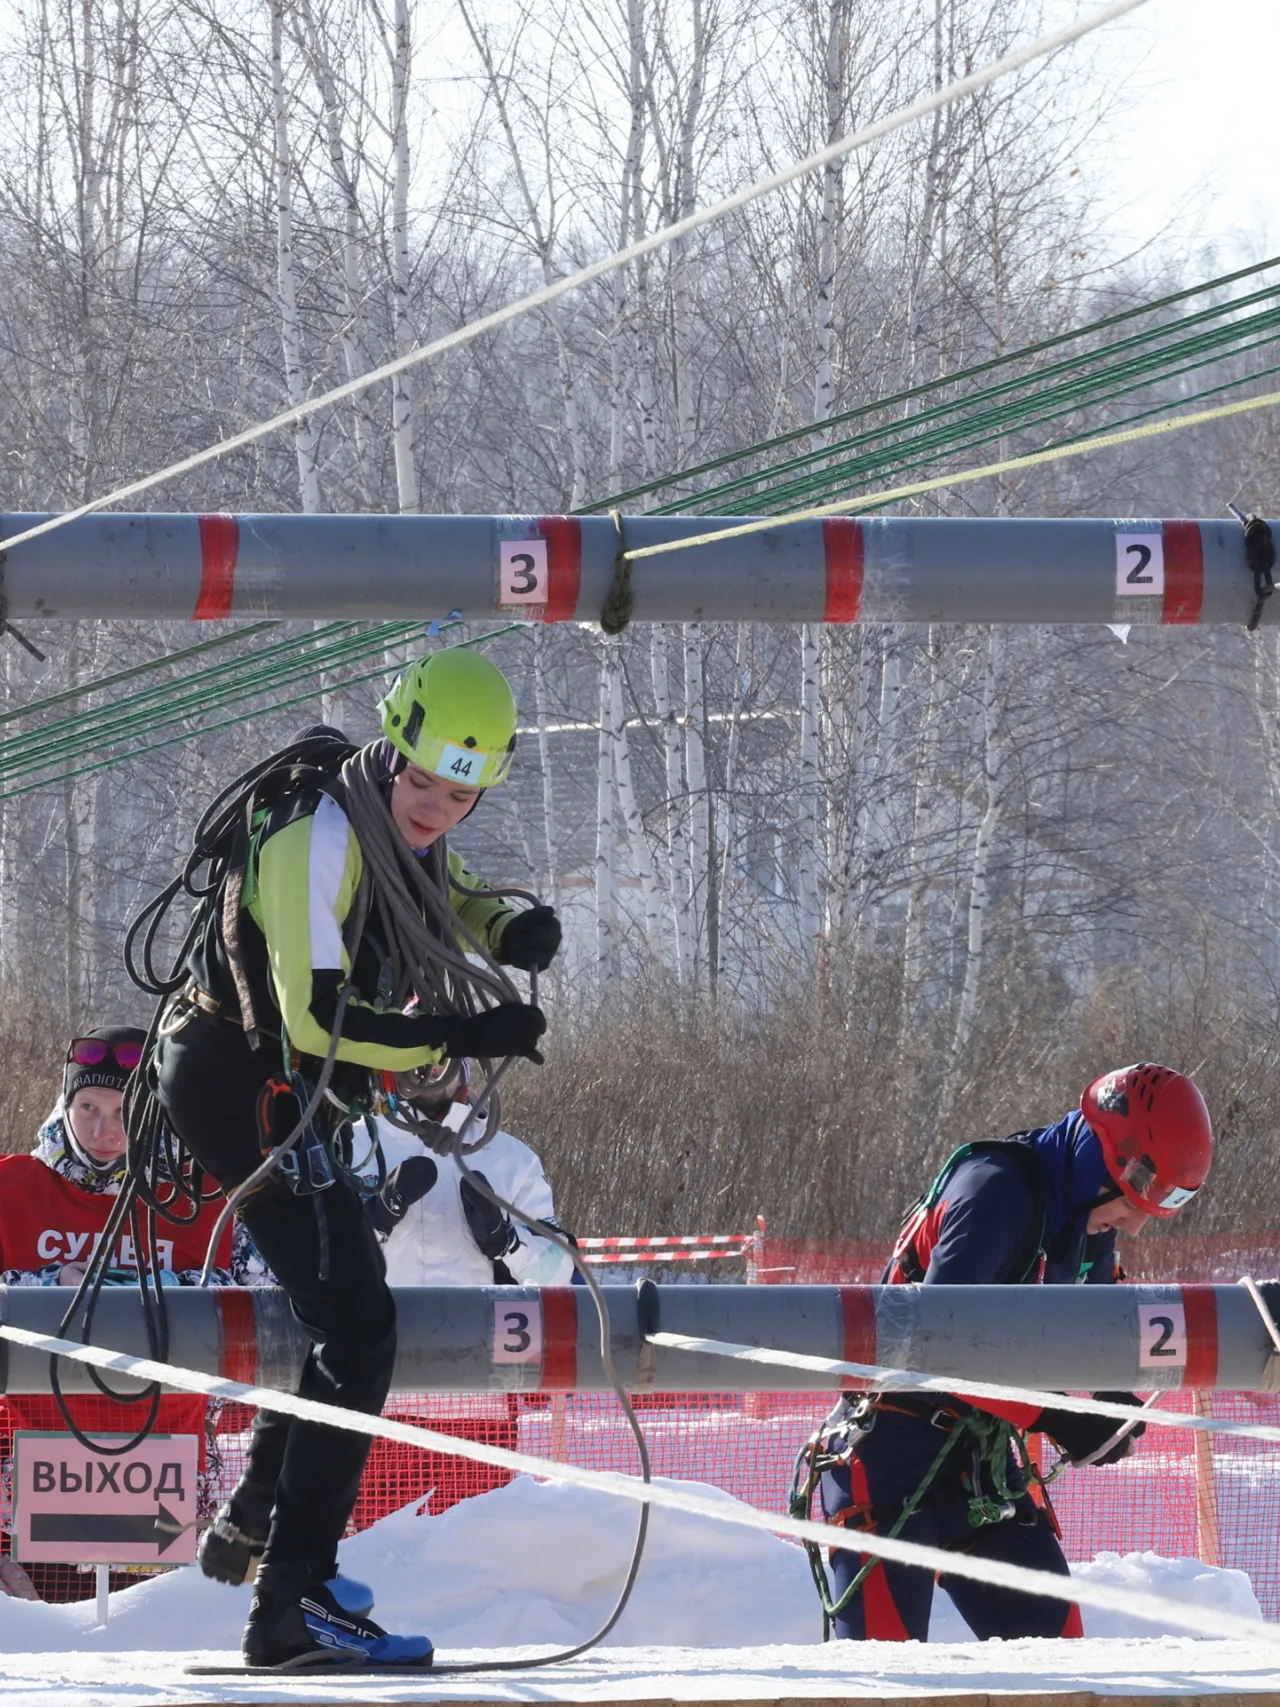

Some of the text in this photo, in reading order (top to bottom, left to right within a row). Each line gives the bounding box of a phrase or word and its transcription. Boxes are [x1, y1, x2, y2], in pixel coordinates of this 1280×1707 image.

[510, 553, 538, 594] 3
[1126, 544, 1153, 584] 2
[450, 757, 473, 777] 44
[503, 1312, 531, 1353] 3
[1149, 1316, 1176, 1356] 2
[33, 1461, 185, 1502] ВЫХОД
